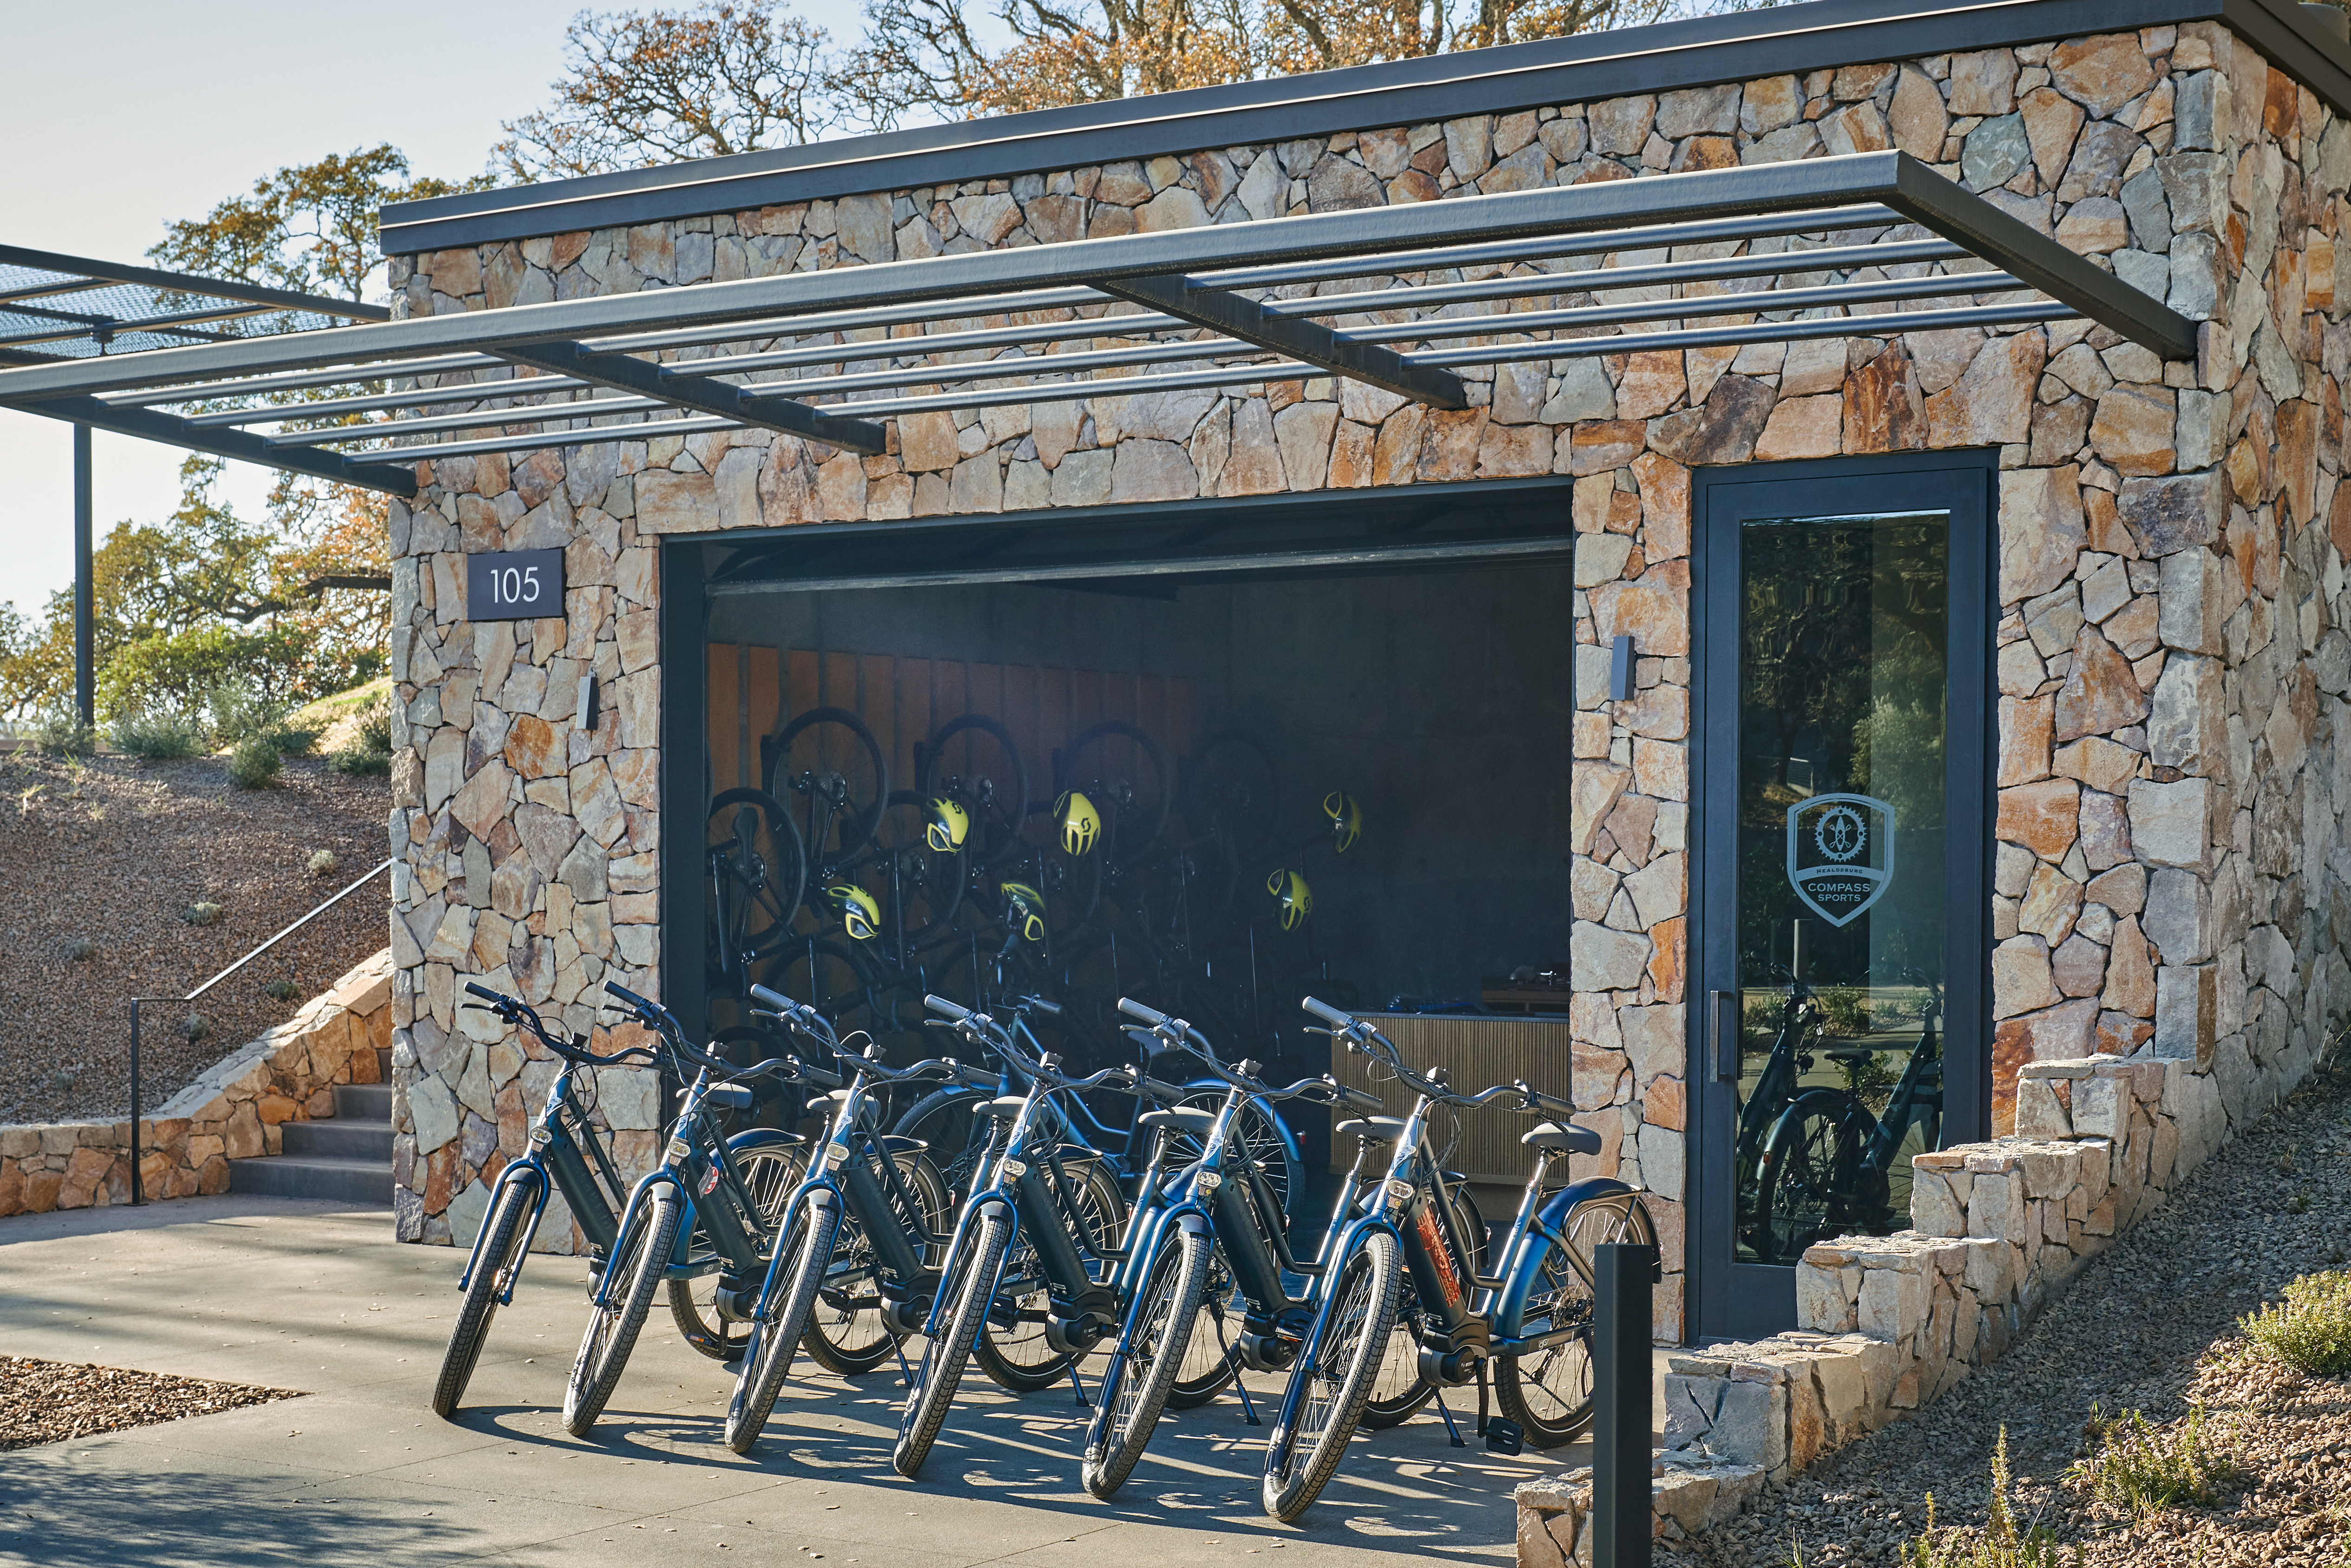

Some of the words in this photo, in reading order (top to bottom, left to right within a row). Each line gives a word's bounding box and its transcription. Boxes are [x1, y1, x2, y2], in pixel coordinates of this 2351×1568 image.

[490, 566, 539, 603] 105
[1808, 883, 1870, 892] COMPASS
[1818, 894, 1861, 902] SPORTS
